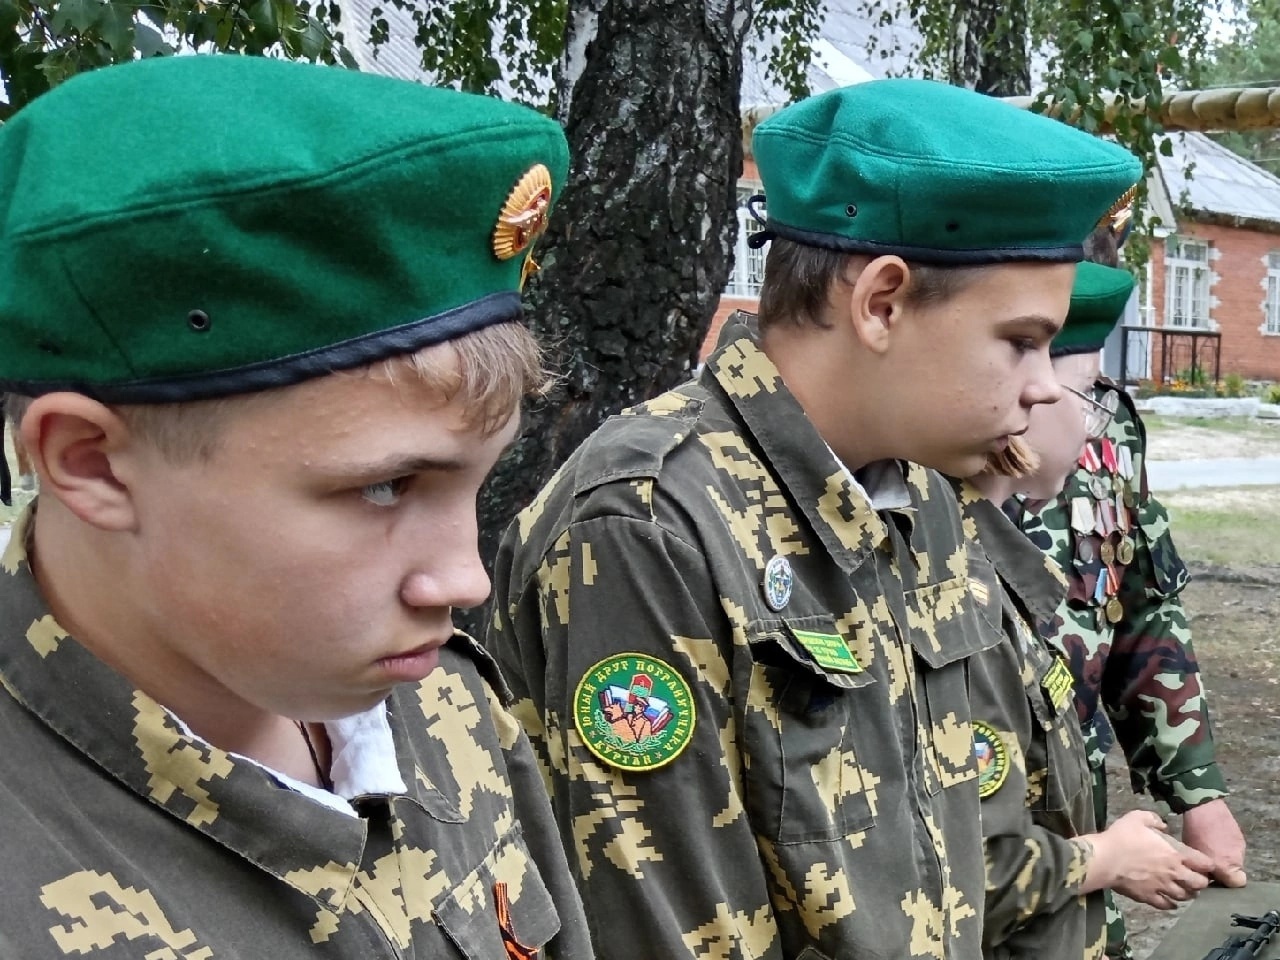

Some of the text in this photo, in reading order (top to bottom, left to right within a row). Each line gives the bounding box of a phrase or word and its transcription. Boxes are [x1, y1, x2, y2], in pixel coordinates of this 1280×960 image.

[581, 660, 689, 751] ЮНЫЙ ДРУГ ПОГРАНИЧНИКА
[593, 740, 652, 765] КУРГАН
